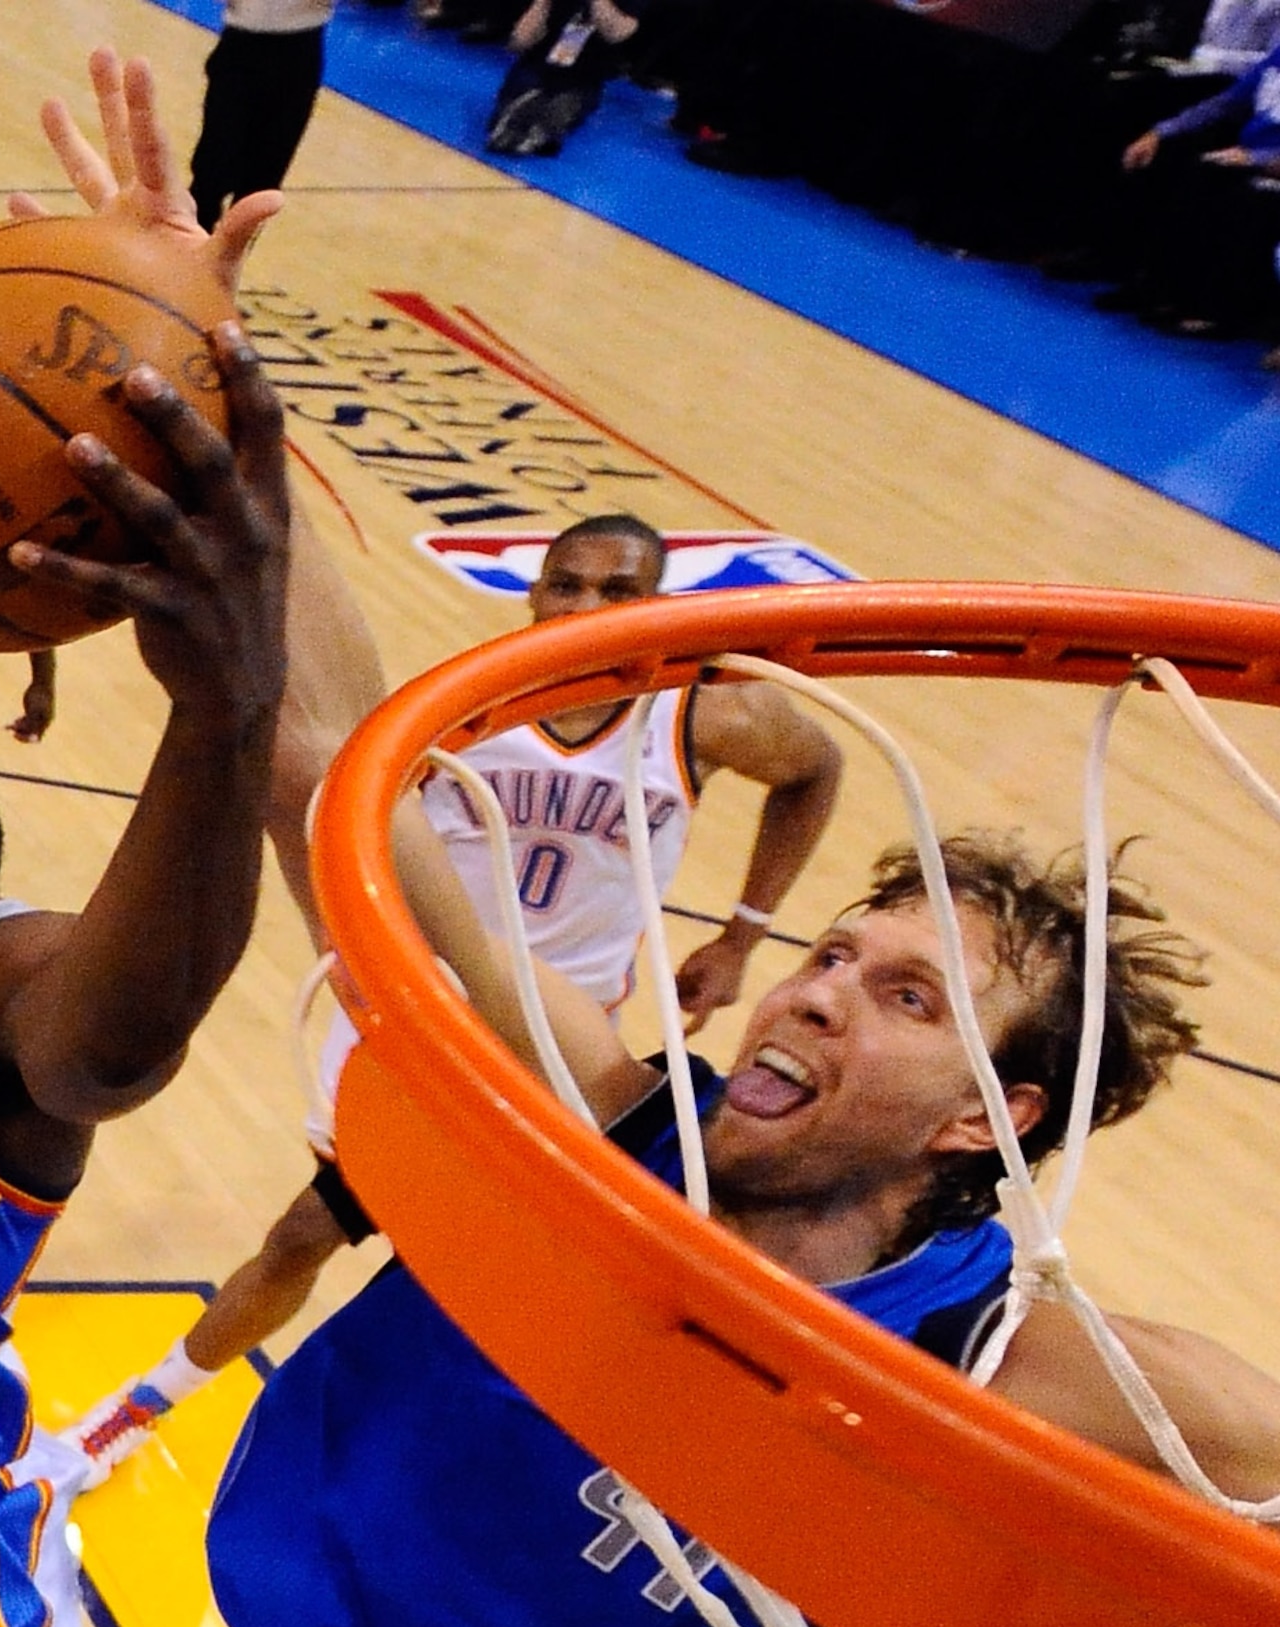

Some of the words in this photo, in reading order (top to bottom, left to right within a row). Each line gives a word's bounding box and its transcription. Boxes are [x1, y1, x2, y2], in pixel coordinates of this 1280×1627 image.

[236, 308, 547, 527] WESTE
[342, 315, 665, 482] FINALS
[517, 837, 574, 914] 0
